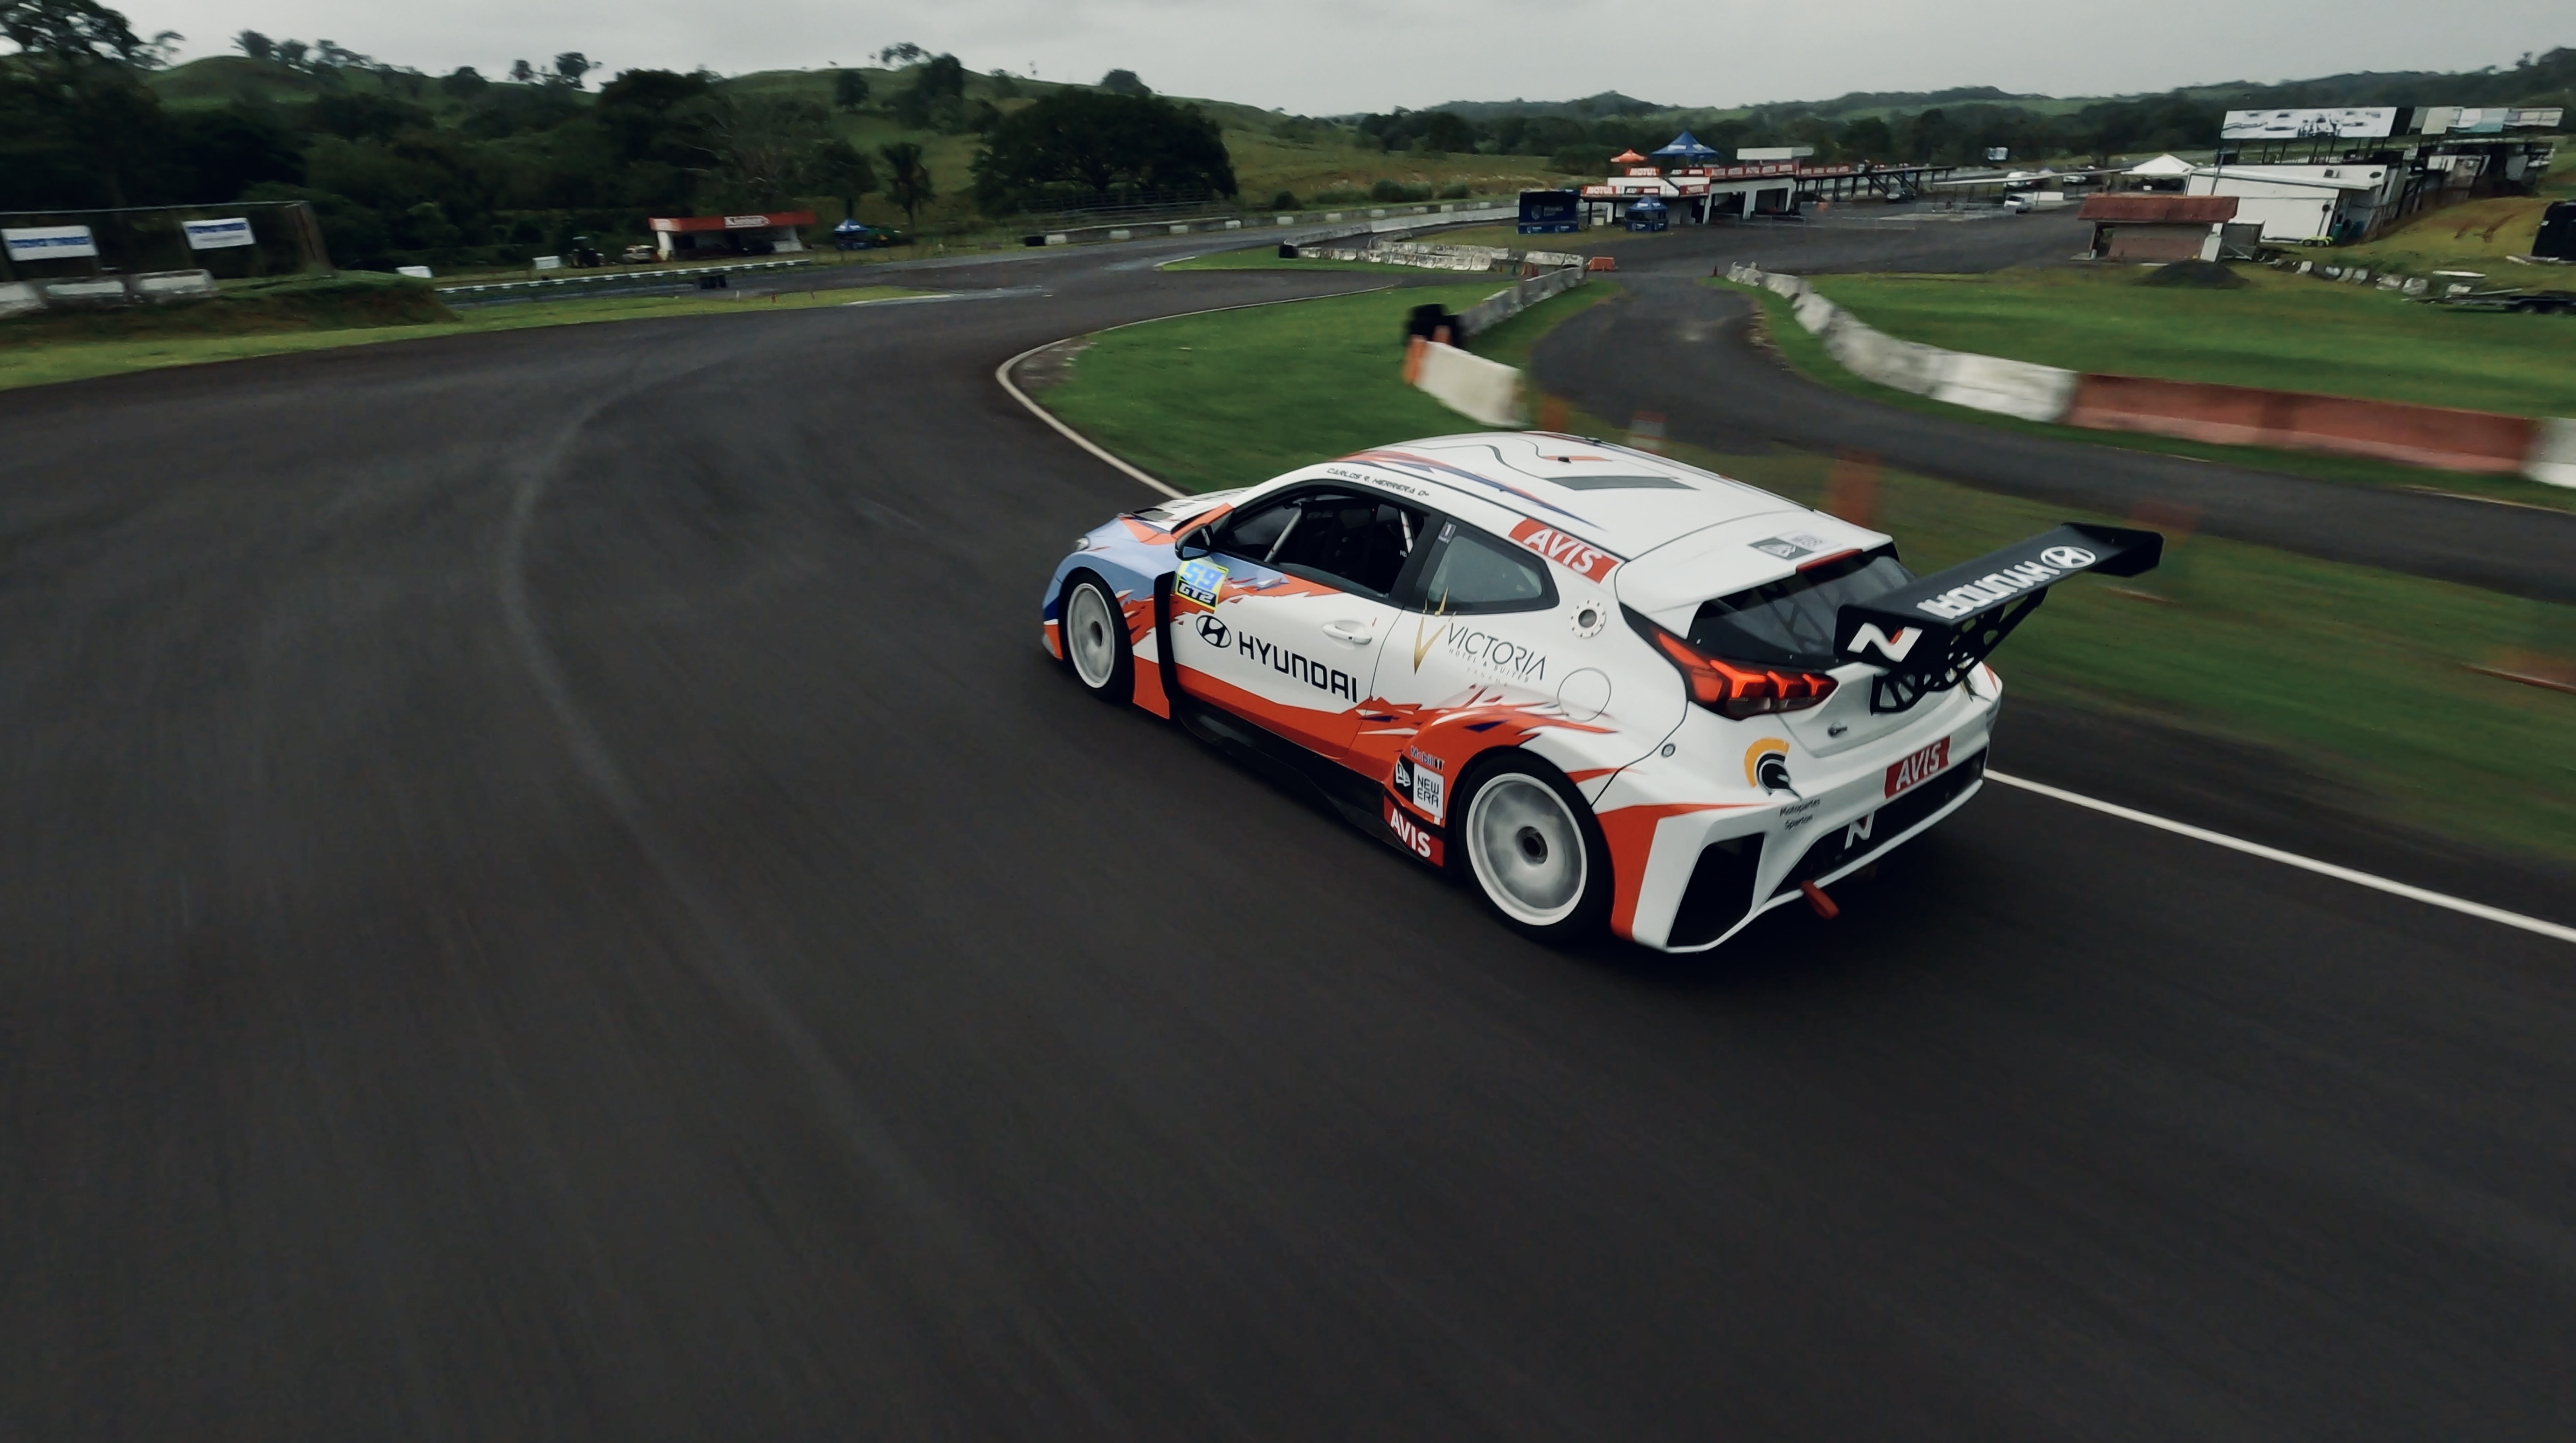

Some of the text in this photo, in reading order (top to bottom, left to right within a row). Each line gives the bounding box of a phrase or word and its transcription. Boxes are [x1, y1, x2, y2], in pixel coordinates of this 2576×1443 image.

[1327, 468, 1362, 479] CARLOS
[1523, 528, 1603, 573] AVIS
[1179, 582, 1214, 604] GT2
[1182, 562, 1223, 591] 59
[1916, 561, 2060, 620] HYUNDAI
[1239, 630, 1357, 704] HYUNDAI
[1448, 622, 1546, 681] VICTORIA
[1449, 648, 1477, 664] HOTEL
[1417, 774, 1439, 795] NEW
[1896, 742, 1942, 791] AVIS
[1417, 787, 1439, 808] ERA
[1391, 808, 1431, 857] AVIS
